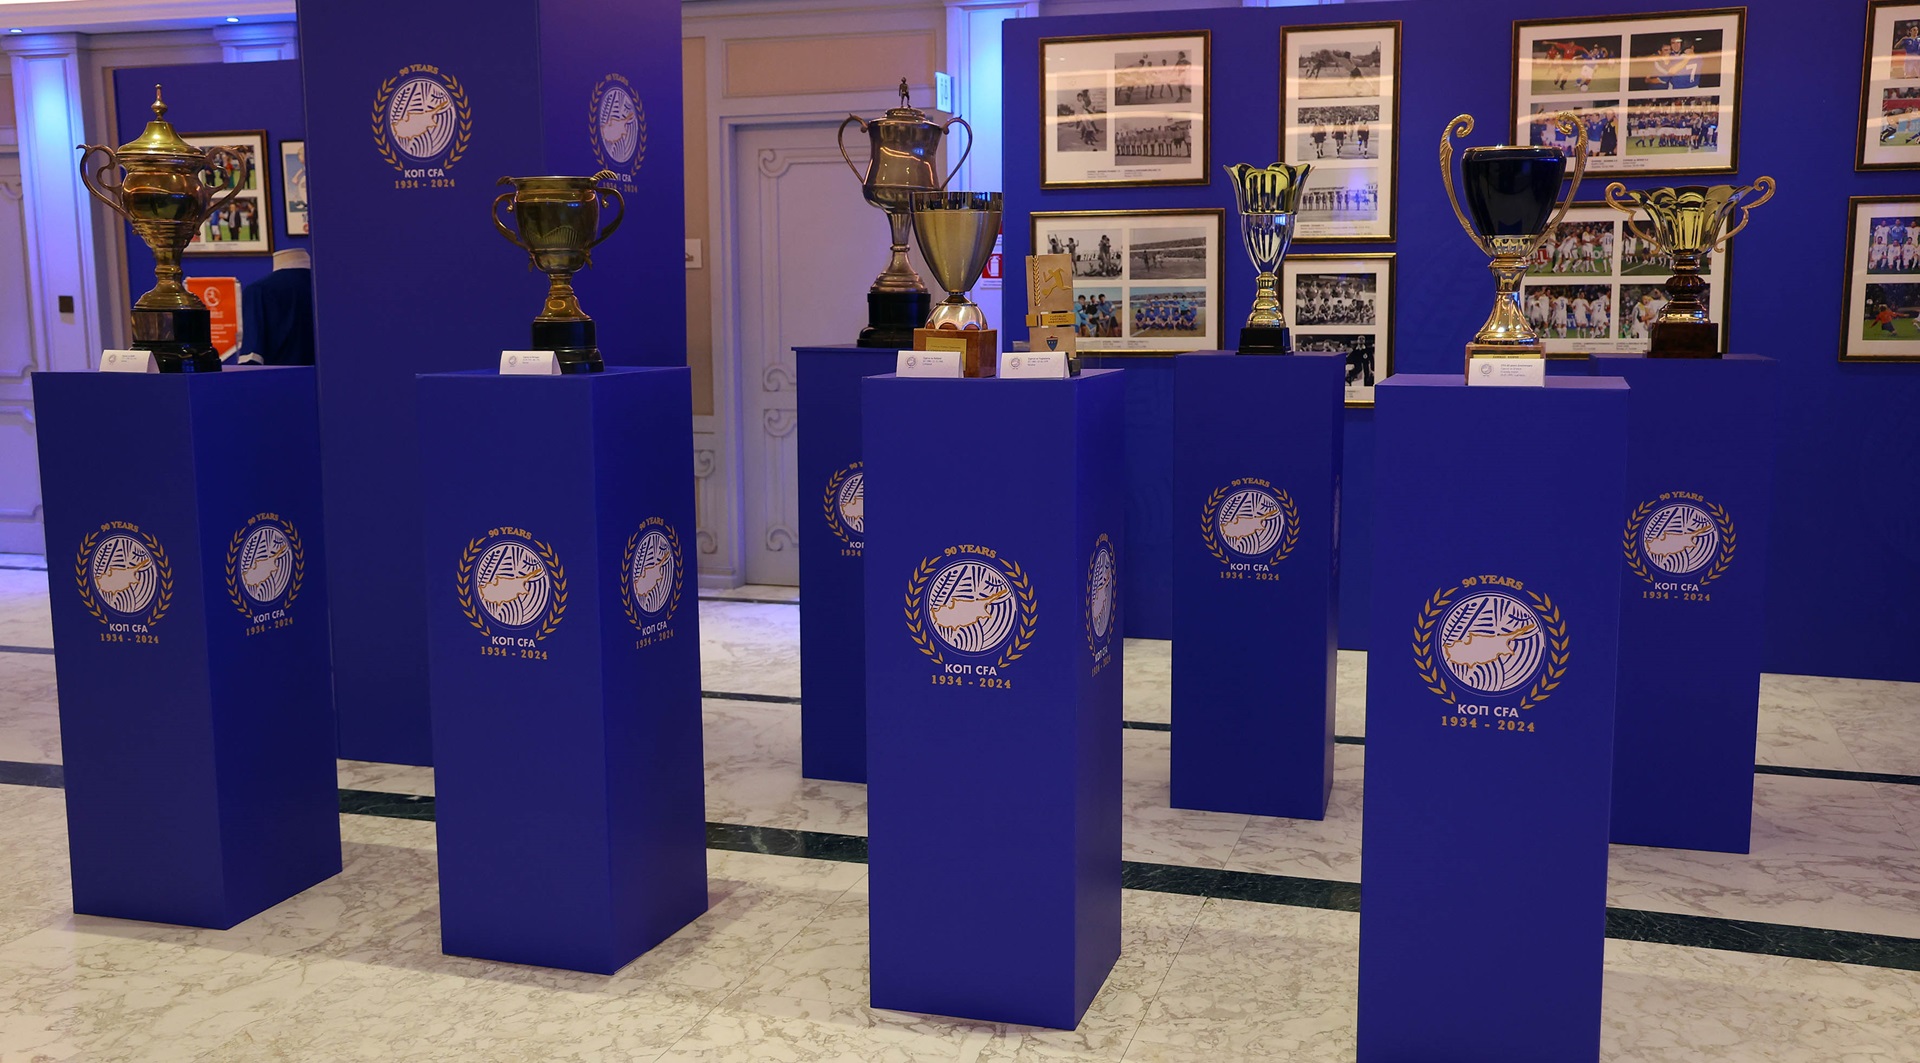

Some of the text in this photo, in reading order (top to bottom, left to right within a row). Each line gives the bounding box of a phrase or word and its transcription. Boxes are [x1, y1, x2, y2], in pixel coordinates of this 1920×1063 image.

[410, 64, 438, 74] YEARS
[1686, 64, 1697, 82] 7
[427, 169, 444, 177] CFA
[395, 180, 418, 188] 1934
[430, 179, 455, 187] 2024
[1242, 477, 1270, 487] YEARS
[1660, 491, 1704, 502] 90 YEARS
[256, 512, 279, 521] YEARS
[100, 520, 139, 533] 90 YEARS
[488, 526, 532, 540] 90 YEARS
[944, 544, 997, 559] 90 YEARS
[1220, 571, 1243, 579] 1934
[1461, 574, 1523, 590] 90 YEARS
[1643, 591, 1669, 599] 1934
[1683, 593, 1710, 601] 2024
[271, 609, 285, 619] CFA
[131, 624, 148, 633] CFA
[246, 624, 265, 636] 1934
[656, 620, 667, 631] CFA
[100, 633, 123, 642] 1934
[135, 635, 159, 644] 2024
[517, 638, 536, 647] CFA
[481, 646, 507, 656] 1934
[520, 649, 548, 660] 2024
[975, 665, 998, 676] CFA
[931, 674, 963, 686] 1934
[980, 677, 1011, 689] 2024
[1493, 706, 1519, 718] CFA
[1441, 715, 1477, 729] 1934
[1498, 719, 1535, 732] 2024
